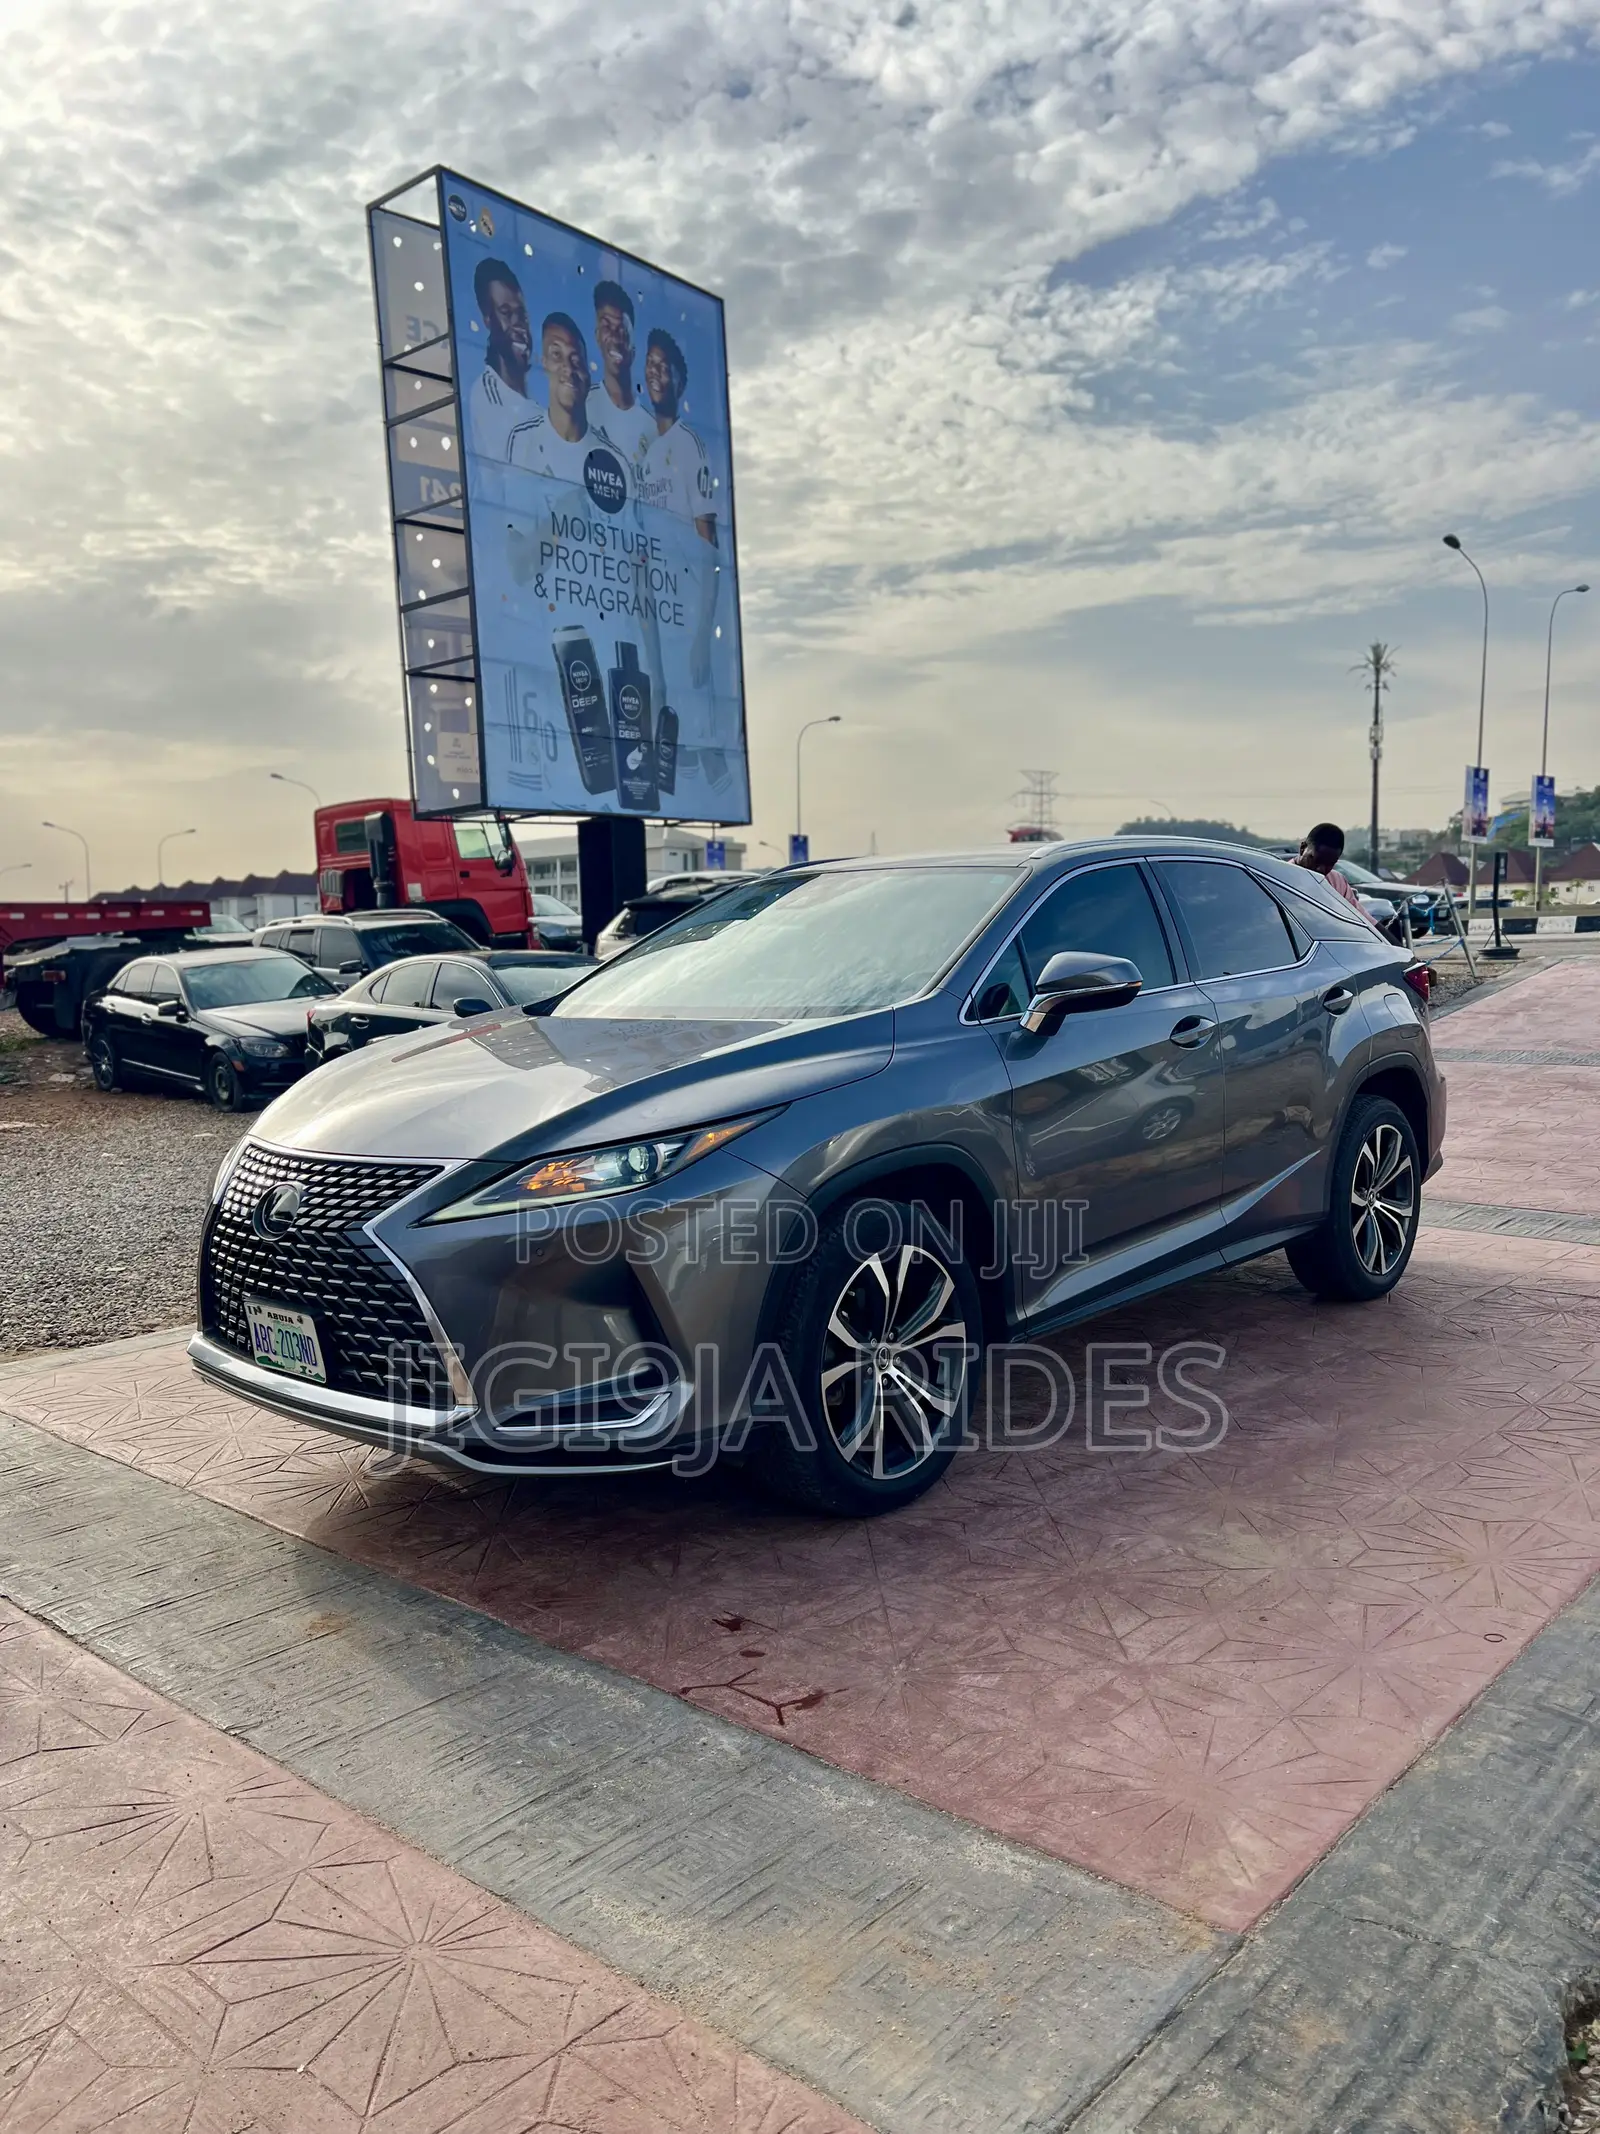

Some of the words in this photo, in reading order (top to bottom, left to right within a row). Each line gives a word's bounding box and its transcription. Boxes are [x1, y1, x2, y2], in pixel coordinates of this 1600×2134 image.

[588, 467, 623, 488] NIVEA
[593, 483, 620, 500] MEN
[551, 511, 667, 567] MOISTURE,
[540, 541, 677, 595] PROTECTION
[534, 573, 548, 599] &
[554, 577, 685, 627] FRAGRANCE
[572, 670, 588, 678] NIVEA
[571, 695, 598, 708] DEEP
[622, 696, 640, 705] NIVEA
[618, 729, 641, 740] DEEP
